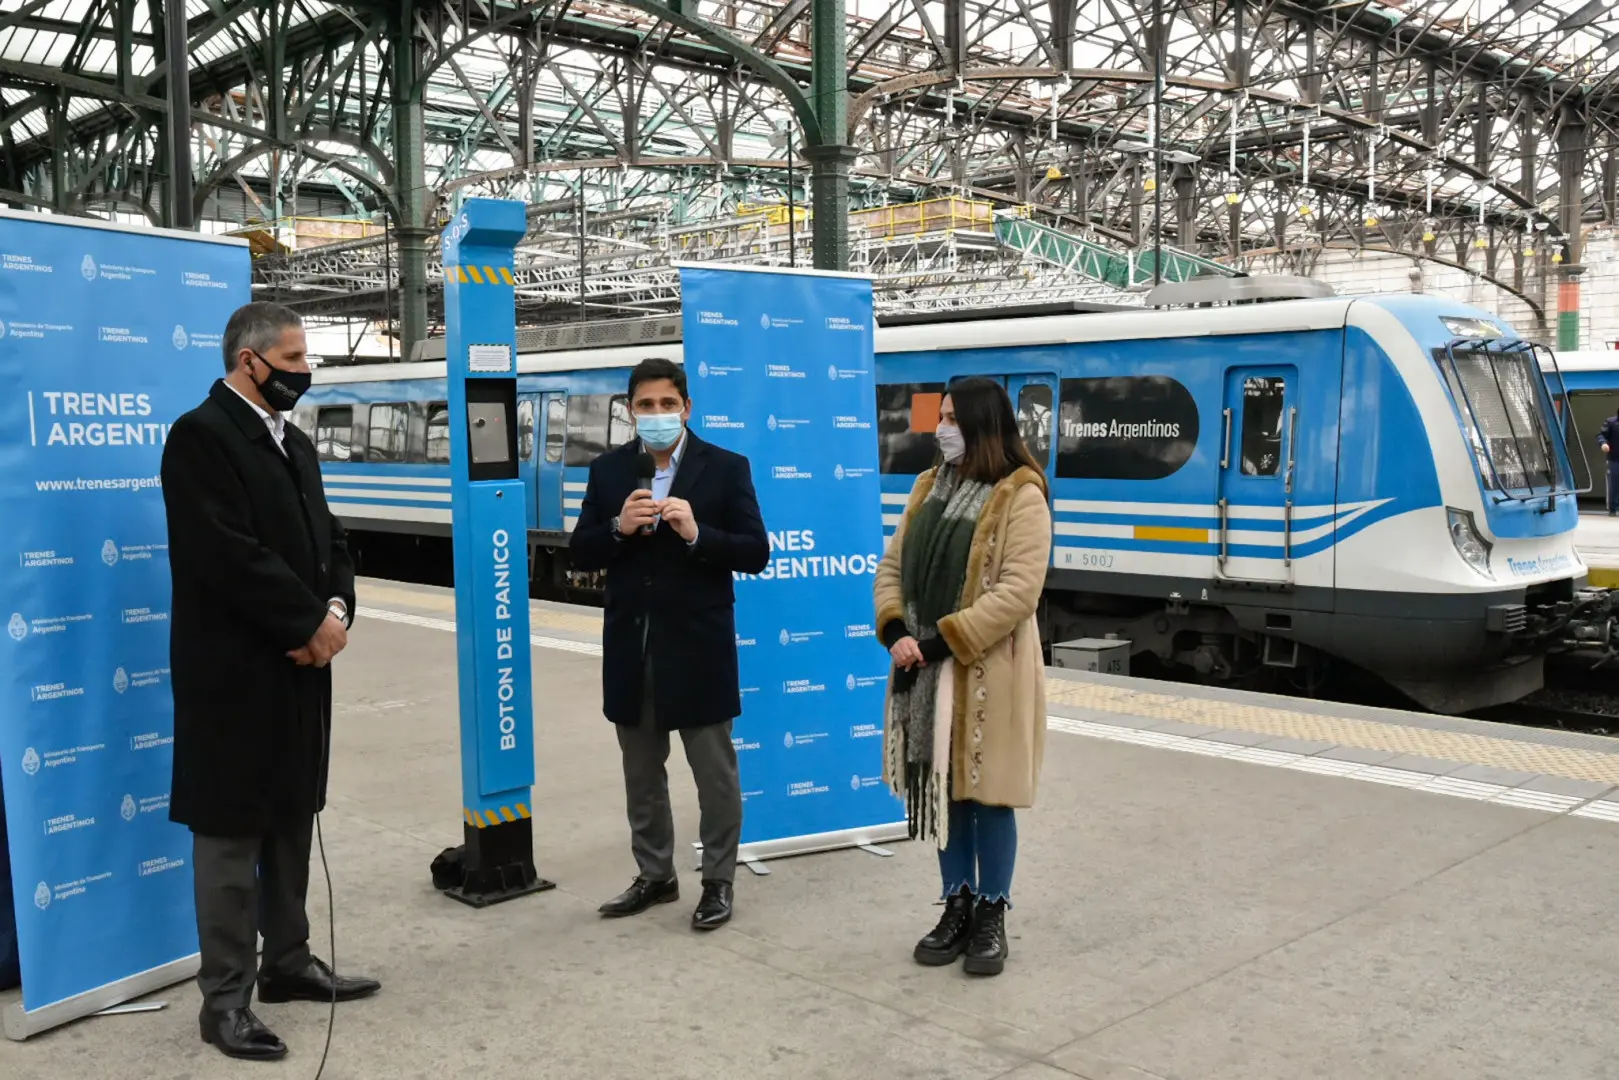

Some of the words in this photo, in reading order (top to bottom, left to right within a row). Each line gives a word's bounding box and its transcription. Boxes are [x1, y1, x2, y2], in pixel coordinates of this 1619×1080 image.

[2, 254, 33, 264] TRENES
[3, 262, 53, 273] ARGENTINOS
[100, 271, 131, 280] Argentina
[184, 272, 210, 280] TRENES
[185, 279, 228, 289] ARGENTINOS
[10, 329, 44, 339] Argentina
[102, 327, 129, 335] TRENES
[102, 334, 148, 343] ARGENTINOS
[191, 340, 220, 348] Argentina
[43, 391, 152, 416] TRENES
[47, 422, 173, 446] ARGENTI
[1064, 419, 1108, 437] Trenes
[1109, 418, 1180, 439] Argentinos
[35, 475, 162, 492] www.trenesargenti
[768, 529, 815, 552] NES
[24, 550, 56, 559] TRENES
[1065, 553, 1072, 564] M
[24, 557, 74, 567] ARGENTINOS
[493, 529, 512, 620] PANICO
[125, 607, 150, 615] TRENES
[32, 624, 66, 635] Argentina
[496, 626, 512, 660] DE
[35, 682, 64, 693] TRENES
[36, 688, 84, 701] ARGENTINOS
[498, 666, 516, 751] BOTON
[44, 756, 76, 768] Argentina
[47, 814, 75, 826] TRENES
[48, 817, 95, 835] ARGENTINOS
[142, 856, 167, 868] TRENES
[142, 859, 184, 876] ARGENTINOS
[54, 886, 86, 900] Argentina
